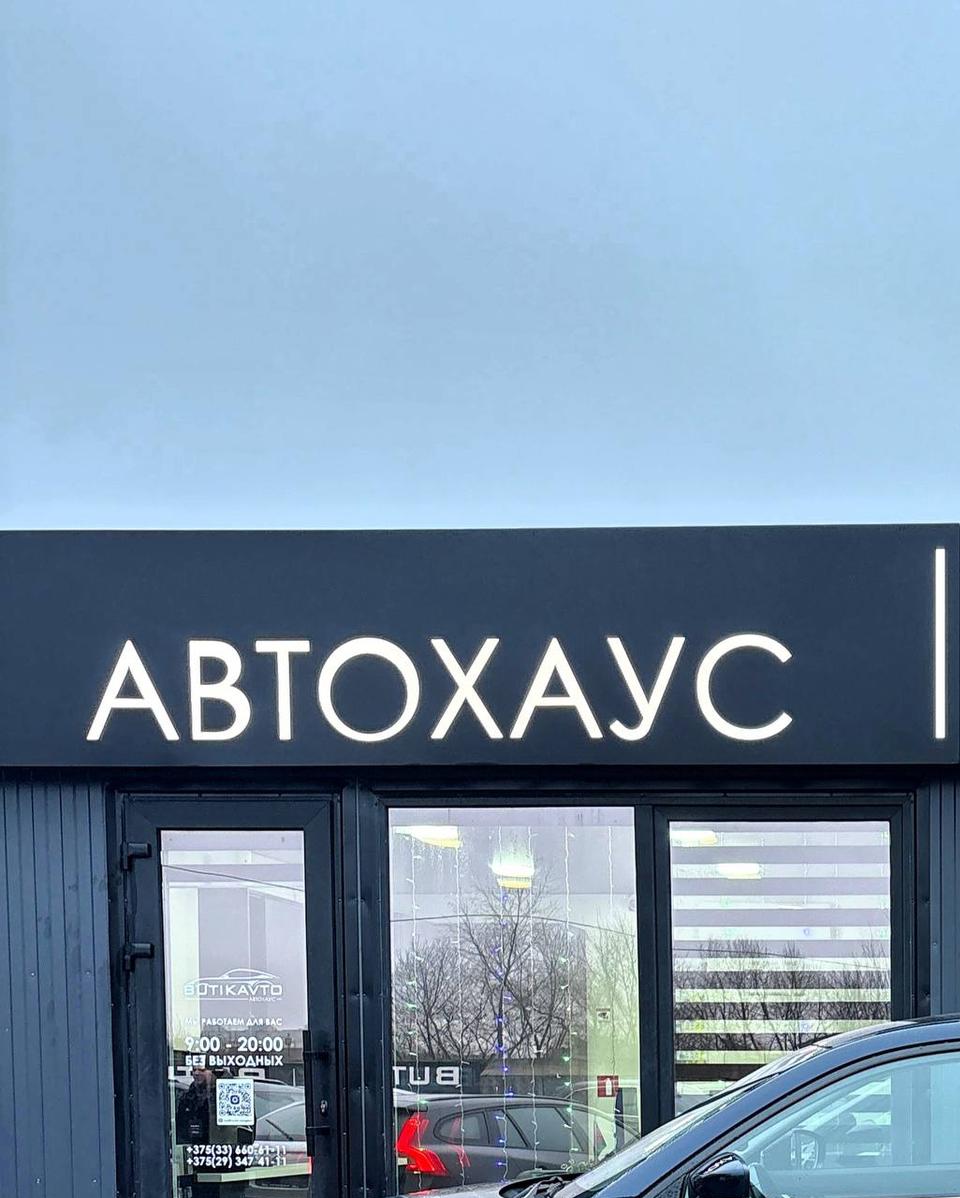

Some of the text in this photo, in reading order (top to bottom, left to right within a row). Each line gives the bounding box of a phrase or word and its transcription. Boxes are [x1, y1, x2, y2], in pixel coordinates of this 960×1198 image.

[86, 633, 794, 743] АВТОХАУС
[183, 984, 283, 996] BUTIKAVTO
[201, 1018, 245, 1026] РАБОТАЕМ
[246, 1018, 263, 1027] ДЛЯ
[265, 1018, 283, 1026] ВАС
[185, 1036, 221, 1052] 9:00
[237, 1036, 283, 1052] 20:00
[185, 1055, 284, 1067] БЕЗ ВЫХОДНЫХ
[186, 1144, 232, 1157] +375(33)
[186, 1156, 232, 1168] +375(29)
